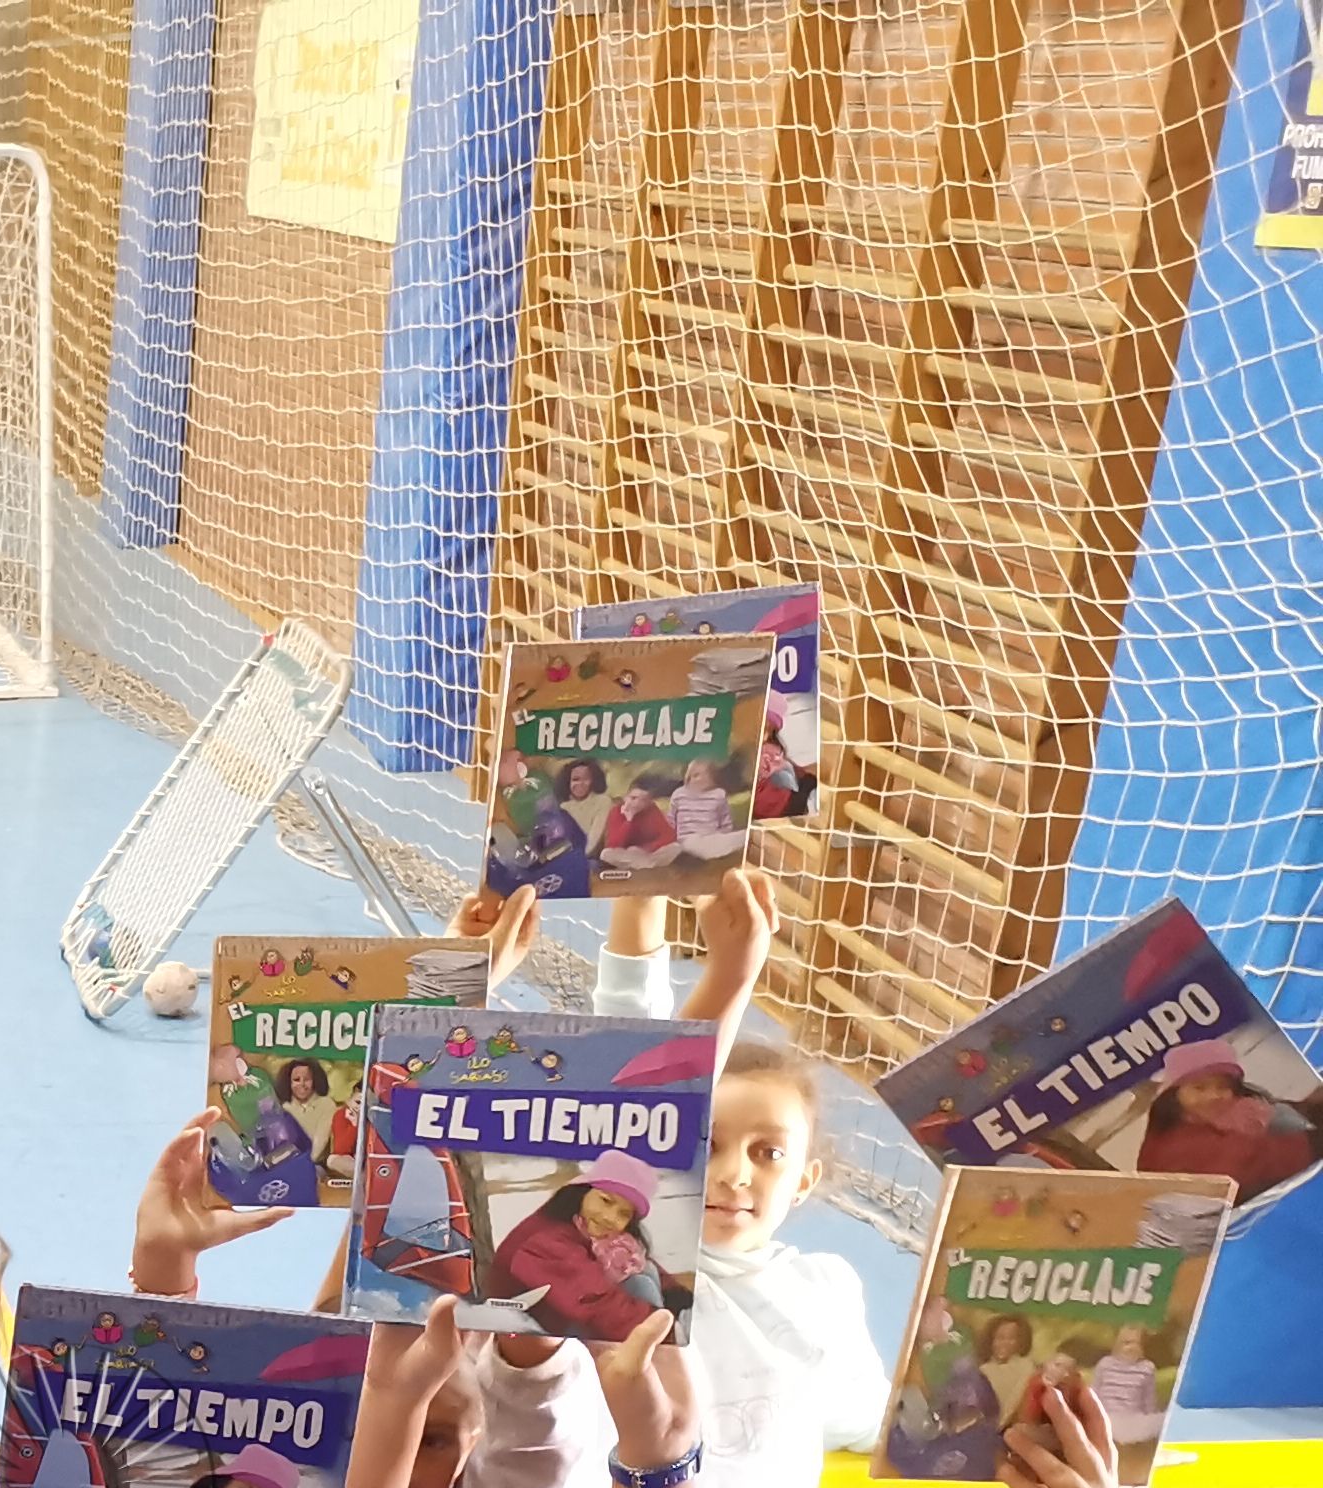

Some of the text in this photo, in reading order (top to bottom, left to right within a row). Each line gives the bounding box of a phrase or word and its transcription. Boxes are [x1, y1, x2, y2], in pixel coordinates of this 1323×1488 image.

[511, 704, 717, 751] EL RECICLAJE
[227, 1002, 372, 1050] EL RECICL
[971, 980, 1223, 1153] EL TIEMPO
[414, 1092, 680, 1152] EL TIEMPO
[947, 1246, 1163, 1308] EL RECICLAJE
[59, 1378, 325, 1449] EL TIEMPO
